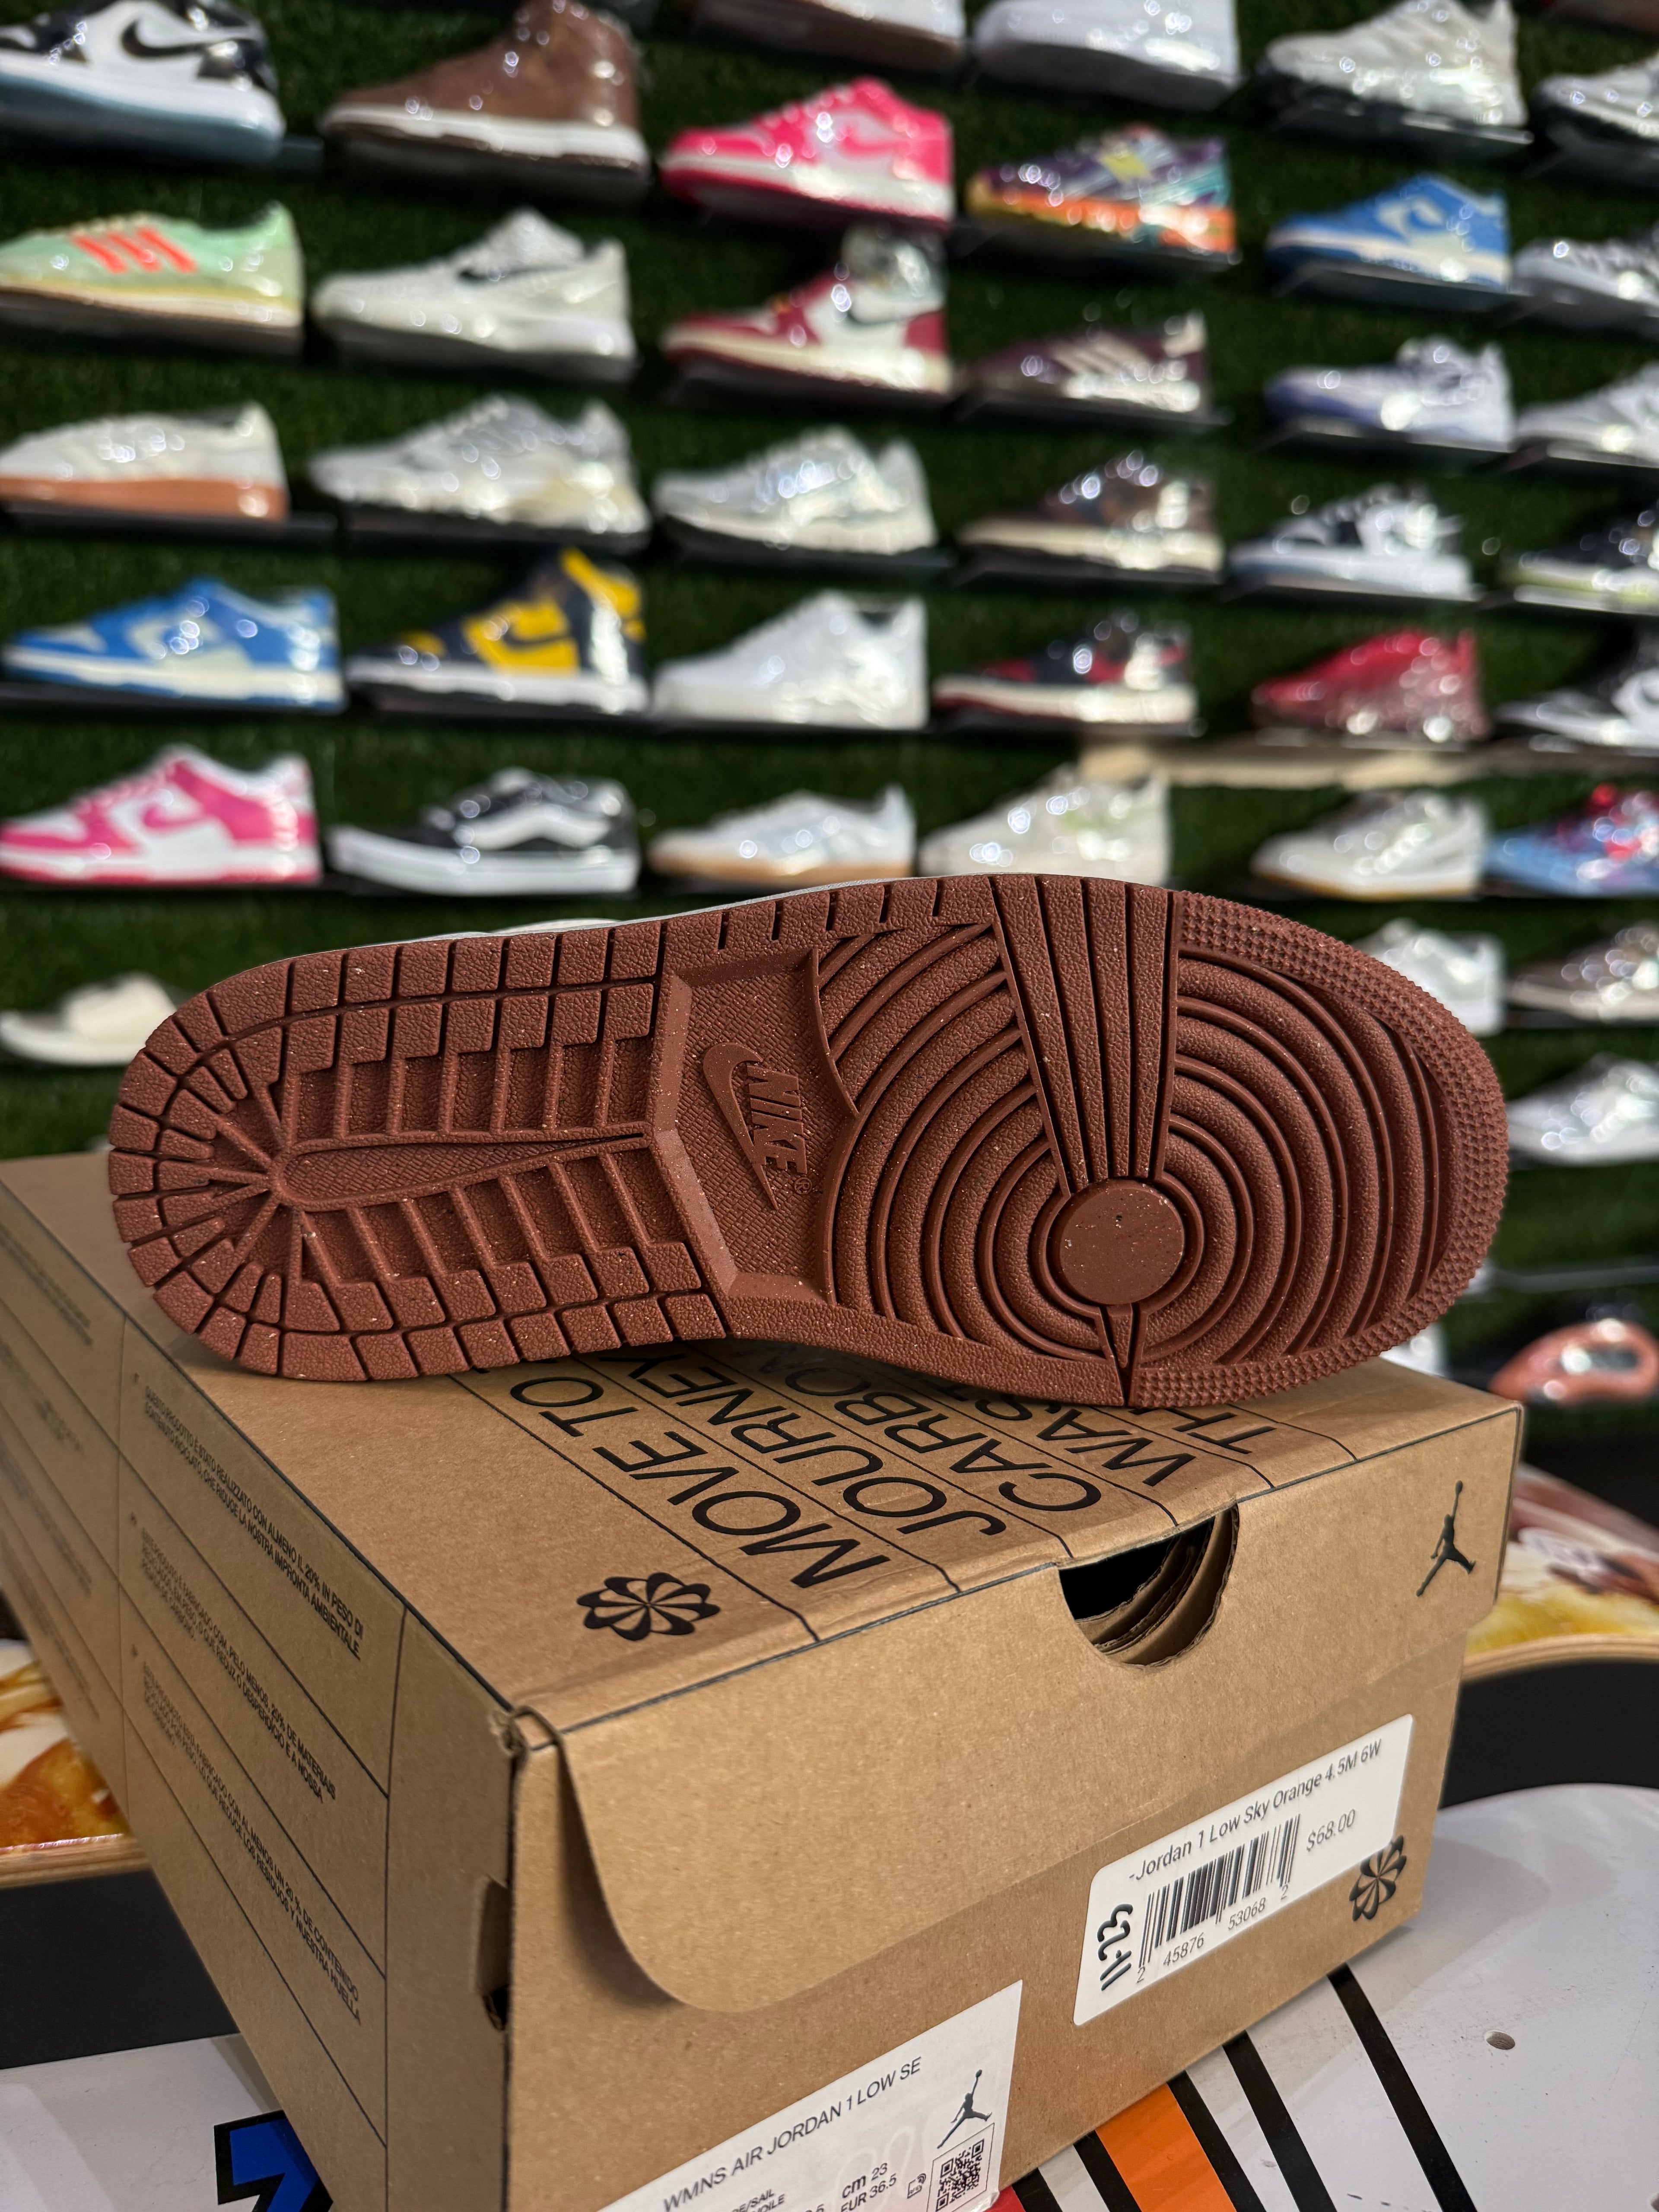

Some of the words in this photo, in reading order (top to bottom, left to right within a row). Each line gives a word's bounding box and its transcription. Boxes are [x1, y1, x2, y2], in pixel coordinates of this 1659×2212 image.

[747, 1065, 808, 1174] NIKE
[510, 1376, 639, 1437] TO
[599, 1353, 1006, 1535] JOURNEY
[199, 1441, 216, 1475] STATO
[216, 1461, 252, 1516] REALIZZATO
[253, 1501, 267, 1532] CON
[268, 1518, 297, 1566] ALMENO
[297, 1551, 305, 1575] IL
[305, 1559, 321, 1593] 20%
[322, 1579, 331, 1604] IN
[331, 1589, 353, 1629] PESO
[353, 1614, 364, 1642] DI
[203, 1466, 216, 1494] CHE
[216, 1480, 238, 1520] RIDUCE
[239, 1506, 247, 1530] LA
[248, 1516, 274, 1561] NOSTRA
[275, 1547, 310, 1603] IMPRONTA
[592, 1431, 891, 1588] MOVE
[204, 1625, 216, 1655] QUE
[216, 1642, 235, 1683] REDUZ
[237, 1670, 242, 1691] O
[243, 1678, 284, 1750] DESPERDÍCIO
[286, 1738, 290, 1759] E
[292, 1745, 297, 1768] A
[298, 1754, 323, 1805] NOSSA
[230, 1643, 245, 1678] PELO
[246, 1665, 270, 1712] MENOS,
[271, 1699, 285, 1732] 20%
[287, 1720, 296, 1748] DE
[298, 1735, 335, 1801] MATERIAIS
[1129, 1845, 1192, 1880] -Jordan
[1198, 1830, 1204, 1848] 1
[1210, 1815, 1240, 1843] Low
[1243, 1799, 1270, 1824] Sky
[1273, 1773, 1322, 1808] Orange
[1361, 1738, 1382, 1762] 6W
[1306, 1808, 1356, 1852] $68.00
[207, 1772, 218, 1804] QUE
[219, 1791, 242, 1841] REDUCE
[243, 1829, 255, 1862] LOS
[257, 1850, 289, 1914] RESIDUOS
[289, 1901, 294, 1923] Y
[296, 1911, 330, 1978] NUESTRA
[330, 1964, 360, 2027] HUELLA
[228, 1789, 241, 1821] CON
[242, 1810, 250, 1836] AL
[251, 1824, 273, 1872] MENOS
[274, 1861, 284, 1888] UN
[286, 1878, 293, 1903] 20
[304, 1905, 313, 1933] DE
[314, 1921, 358, 2003] CONTENIDO
[1137, 1966, 1145, 1983] 2
[1163, 1932, 1205, 1967] 45876
[1228, 1897, 1266, 1931] 53068
[1280, 1884, 1288, 1901] 2
[664, 2167, 727, 2212] WMNS
[731, 2145, 763, 2176] AIR
[767, 2101, 842, 2155] JORDAN
[846, 2094, 852, 2110] 1
[857, 2070, 896, 2105] LOW
[899, 2056, 922, 2080] SE
[841, 2192, 867, 2212] EUR
[870, 2173, 897, 2198] 36.5
[842, 2175, 867, 2199] cm
[871, 2162, 888, 2181] 23
